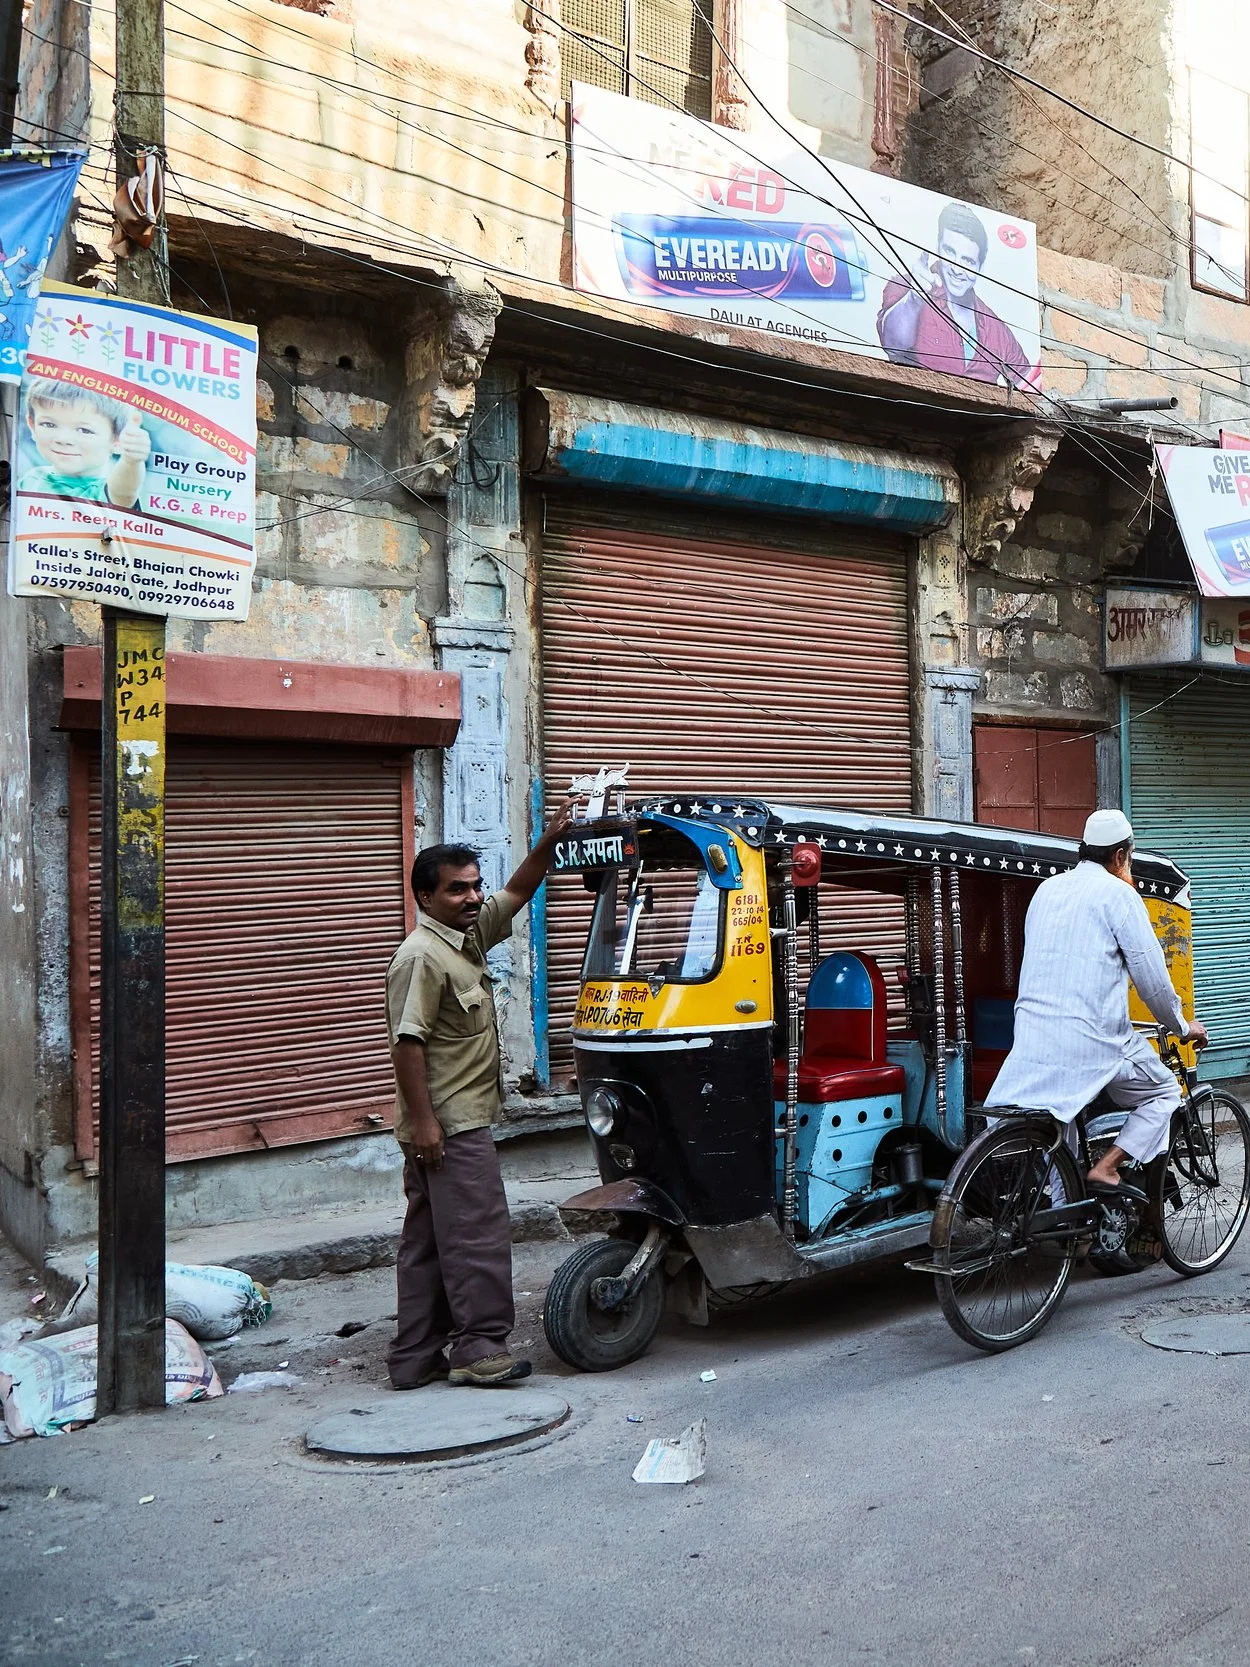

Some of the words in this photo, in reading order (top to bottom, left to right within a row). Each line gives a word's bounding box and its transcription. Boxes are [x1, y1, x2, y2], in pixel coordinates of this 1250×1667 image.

[653, 236, 792, 272] EVEREADY
[657, 270, 738, 283] MULTIPURPOSE
[766, 320, 828, 343] AGENCIES
[124, 325, 241, 380] LITTLE
[123, 362, 241, 400] FLOWERS
[31, 362, 58, 377] AN
[62, 369, 129, 400] ENGLISH
[131, 394, 189, 428] MEDIUM
[192, 423, 247, 462] SCHOOL
[154, 454, 190, 474] Play
[195, 461, 247, 483] Group
[1213, 454, 1250, 475] GIVE
[166, 477, 232, 501] Nursery
[1207, 474, 1236, 494] ME
[28, 505, 65, 521] Mrs.
[72, 511, 118, 528] Reeta
[123, 519, 164, 537] Kalla
[149, 496, 185, 513] K.G.
[191, 502, 204, 516] &
[210, 504, 247, 524] Prep
[27, 543, 79, 560] Kalla's
[84, 550, 130, 569] Street,
[133, 558, 184, 576] Bhajan
[188, 566, 240, 582] Chowki
[35, 560, 82, 576] Inside
[86, 565, 127, 582] Jalori
[130, 573, 169, 591] Gate,
[172, 579, 233, 597] Jodhpur
[30, 574, 134, 601] 07597950490,
[138, 590, 235, 611] 09929706648
[117, 647, 164, 668] JMC
[116, 666, 166, 689] W34
[120, 690, 134, 707] P
[118, 702, 163, 725] 744
[581, 835, 624, 866] सपना
[735, 894, 758, 906] 6181
[732, 914, 763, 927] 665/04
[730, 942, 766, 957] 1169
[620, 986, 649, 1004] वाहिनी
[622, 1007, 644, 1028] सेवा
